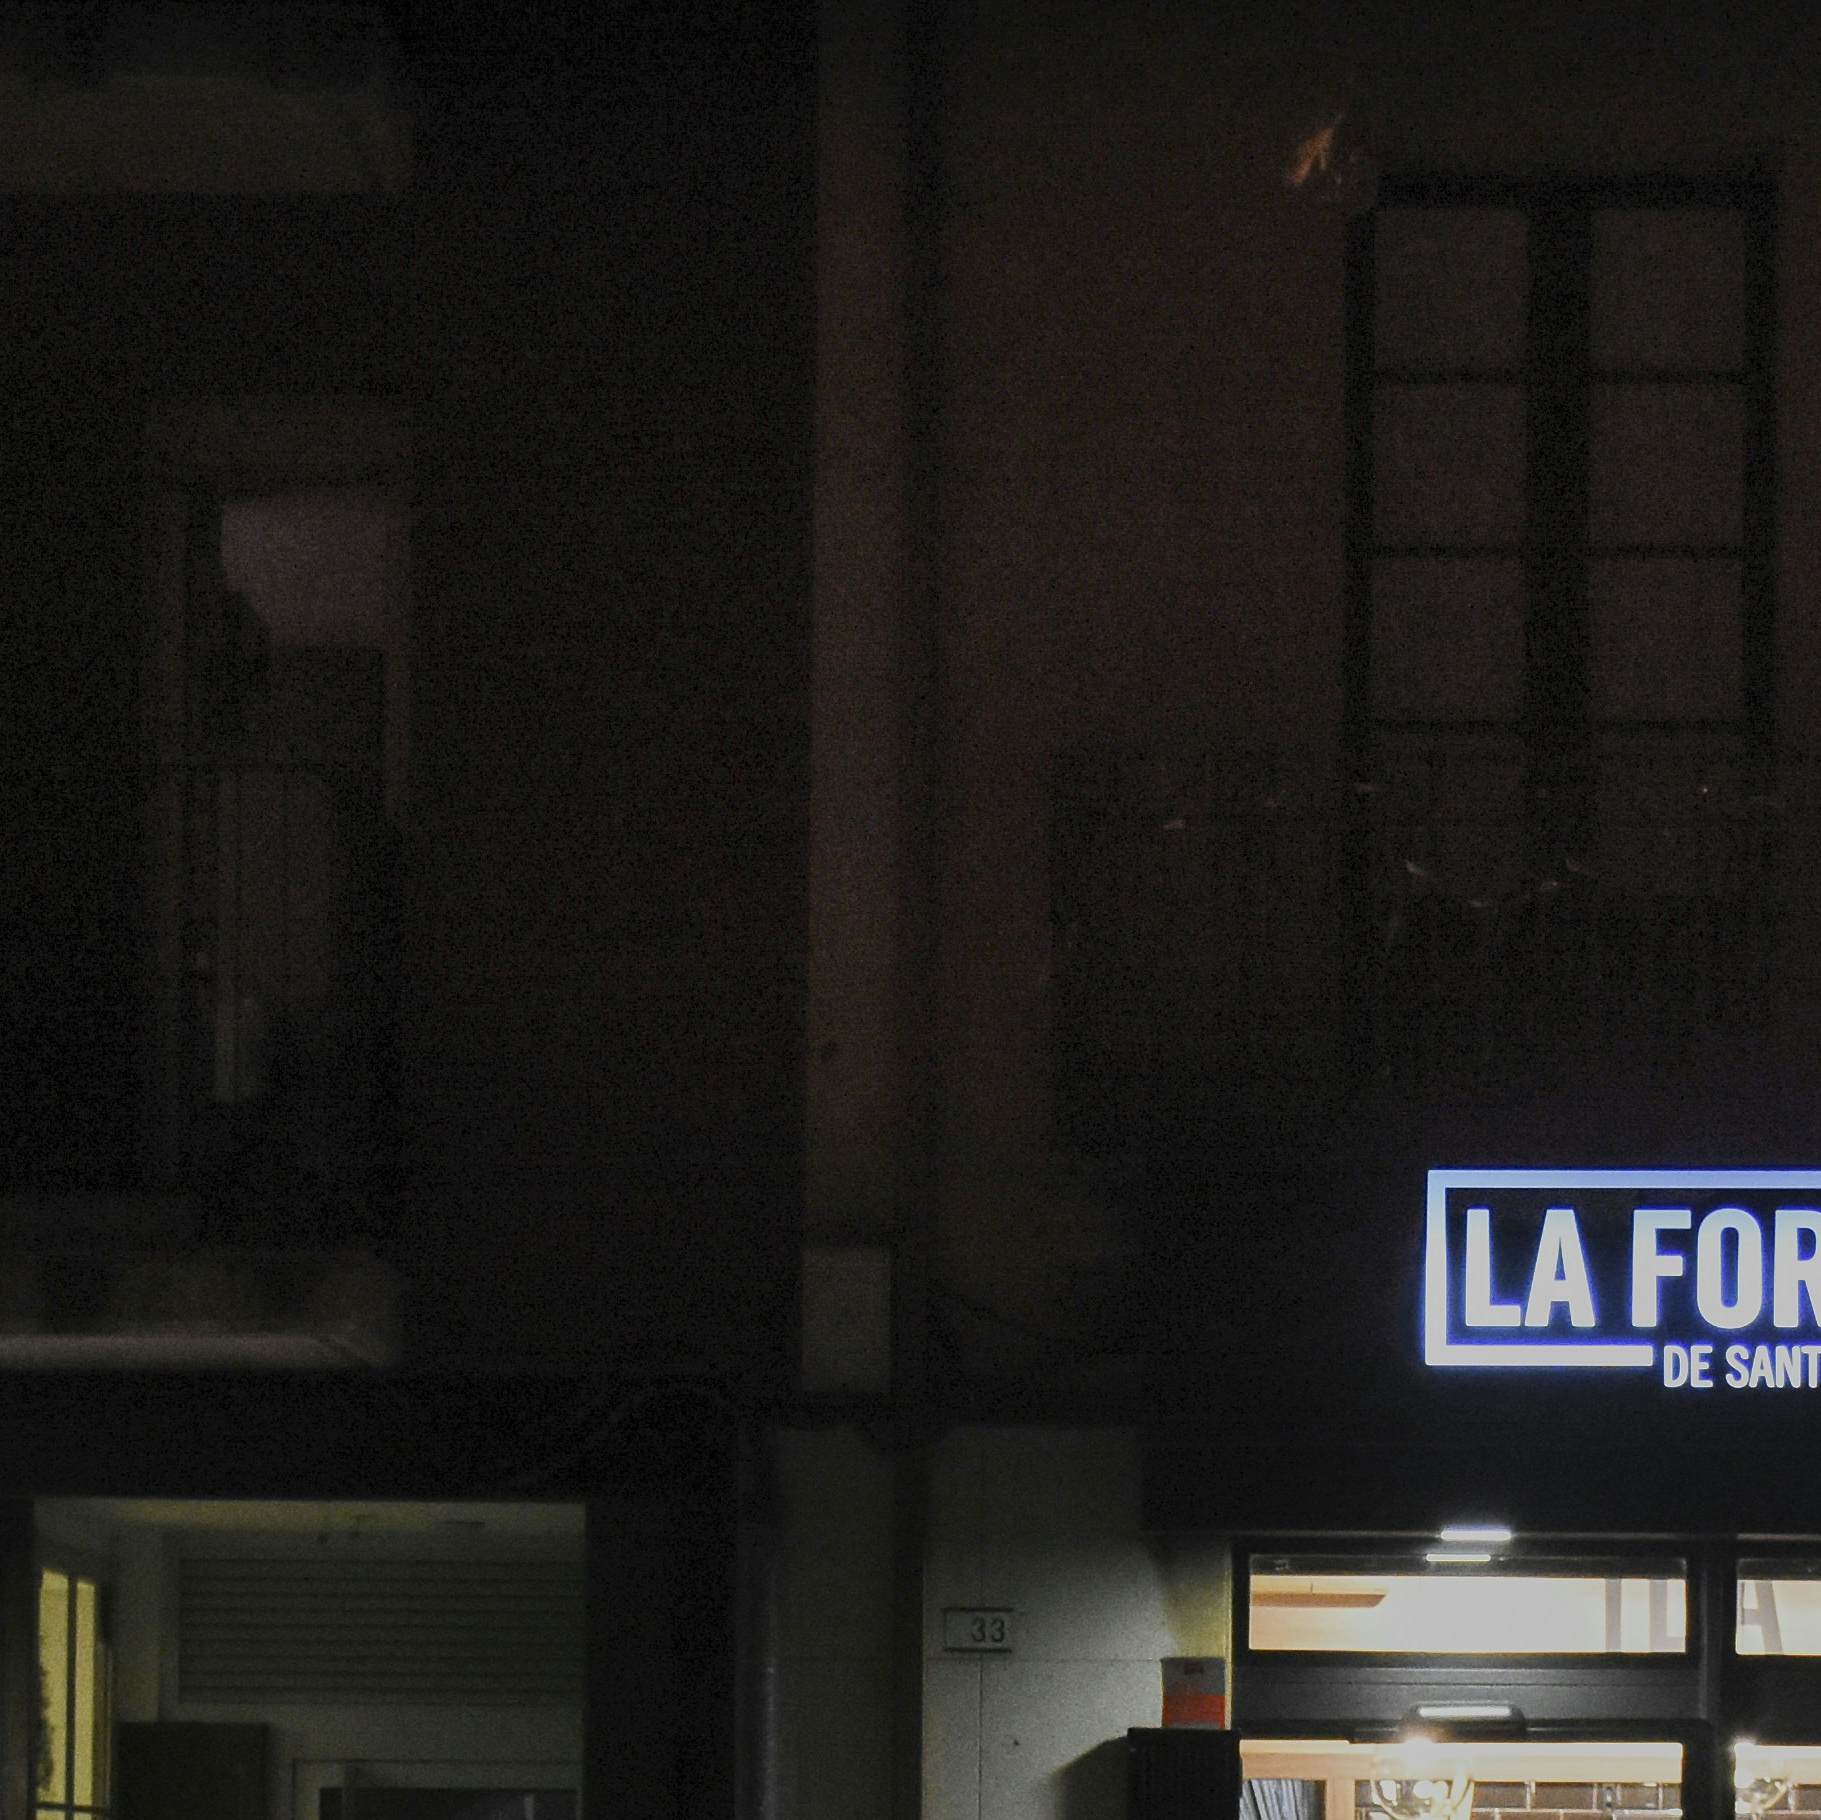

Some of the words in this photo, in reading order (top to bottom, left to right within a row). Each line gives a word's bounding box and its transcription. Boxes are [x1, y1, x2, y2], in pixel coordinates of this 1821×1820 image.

[1464, 1209, 1596, 1328] LA
[1663, 1347, 1713, 1388] DE
[1725, 1347, 1821, 1388] SANT
[971, 1617, 1006, 1643] 33
